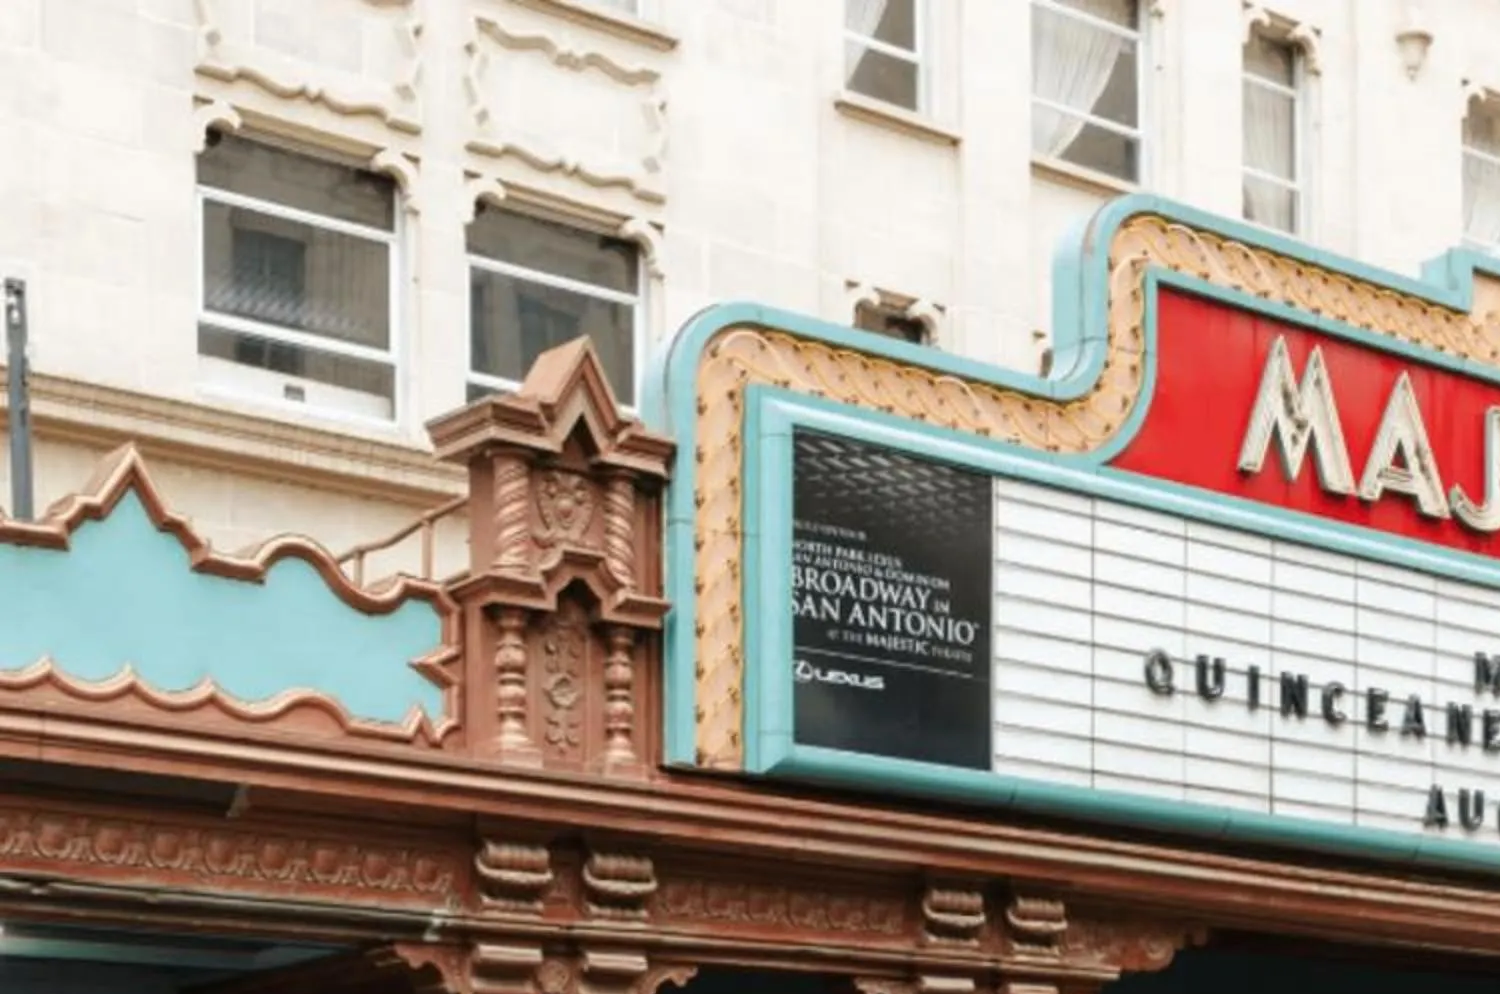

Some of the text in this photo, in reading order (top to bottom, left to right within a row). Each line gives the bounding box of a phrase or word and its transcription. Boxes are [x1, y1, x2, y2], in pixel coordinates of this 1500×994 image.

[792, 566, 950, 614] BROADWAY IN
[848, 603, 977, 646] ANTONIO
[813, 667, 885, 689] LEXUS
